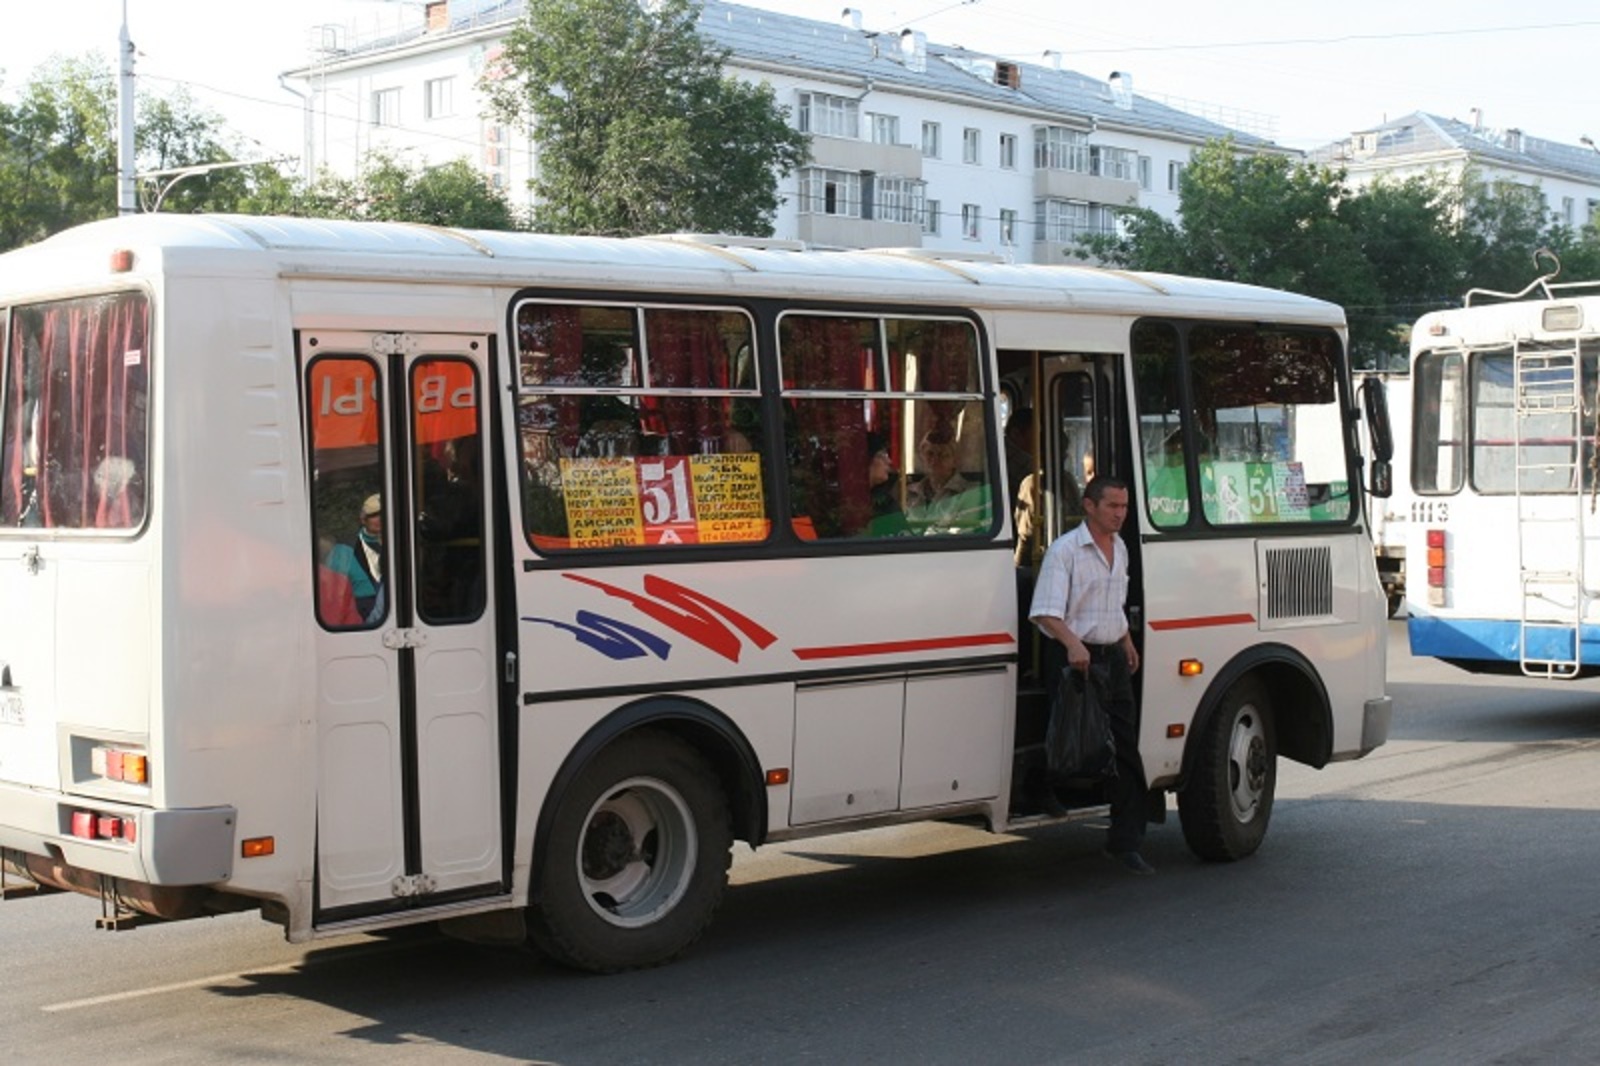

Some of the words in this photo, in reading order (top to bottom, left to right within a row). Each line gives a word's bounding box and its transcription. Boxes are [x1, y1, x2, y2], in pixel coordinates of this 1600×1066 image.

[710, 464, 742, 473] ЖБК
[573, 469, 617, 479] СТАРТ
[640, 460, 694, 524] 51
[730, 483, 755, 492] ДВОР
[1249, 477, 1276, 515] 51
[1411, 501, 1449, 523] 1113
[711, 522, 752, 530] СТАРТ
